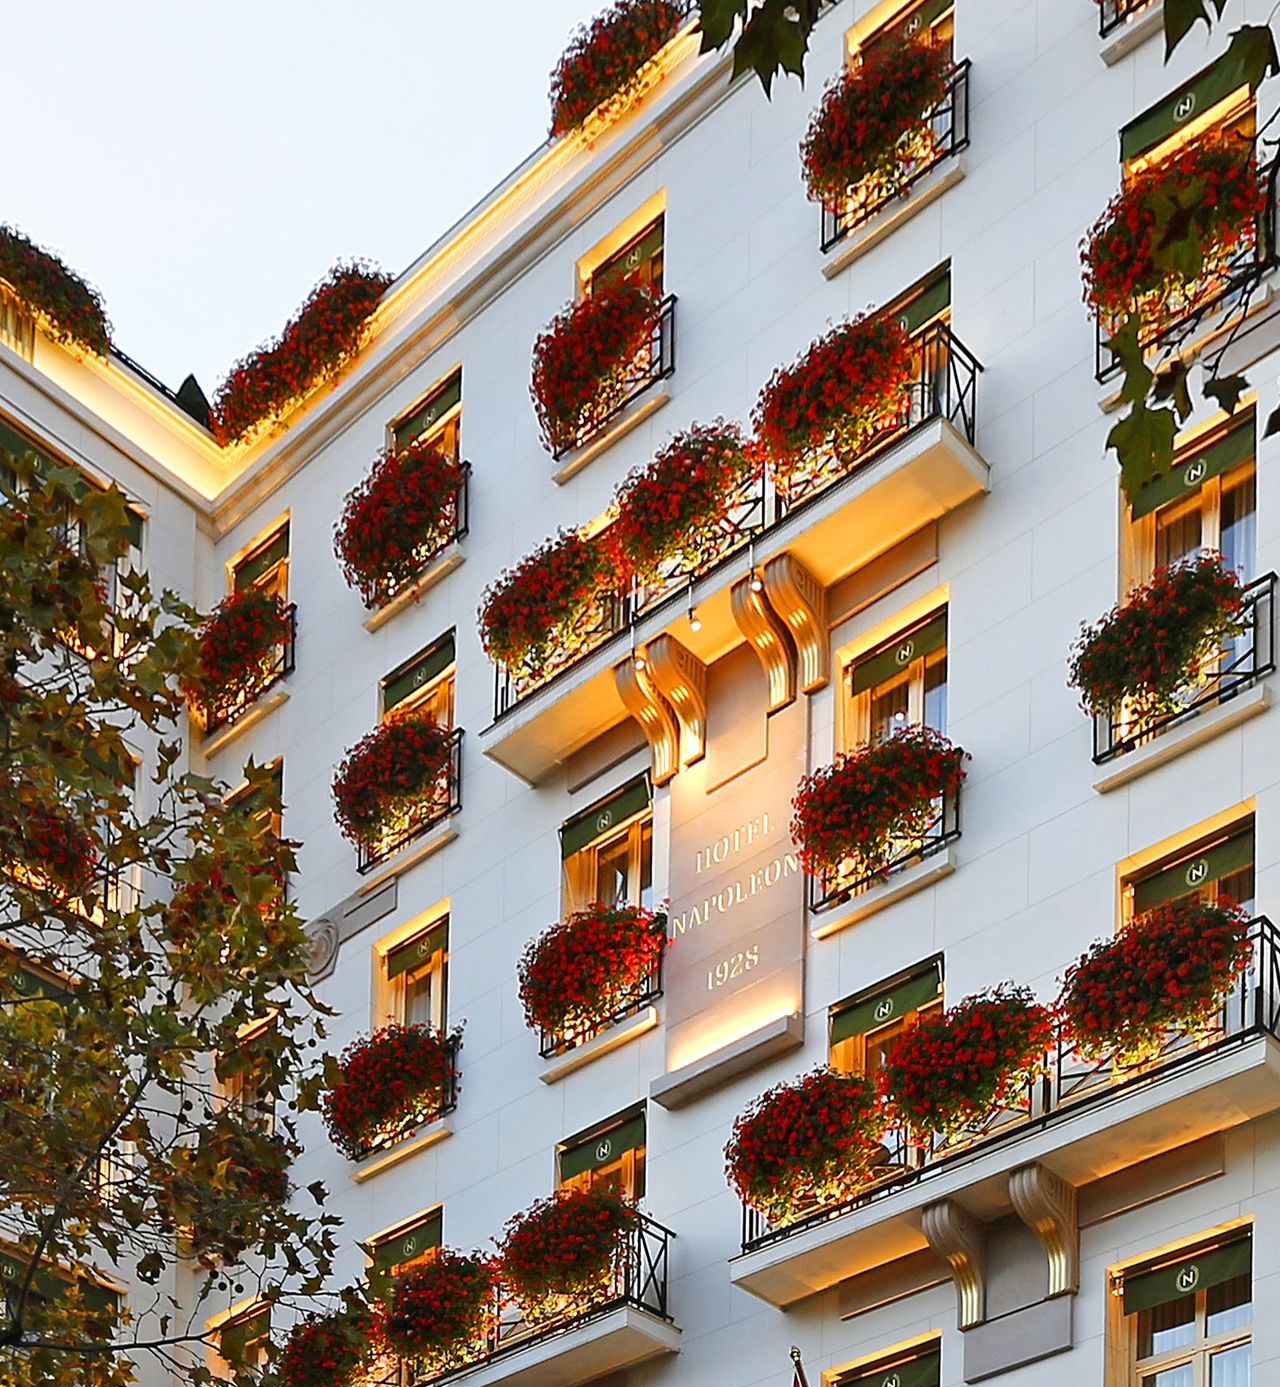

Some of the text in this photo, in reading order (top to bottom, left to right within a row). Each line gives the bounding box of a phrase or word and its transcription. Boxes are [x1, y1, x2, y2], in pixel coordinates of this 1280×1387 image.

[695, 812, 775, 874] HOTEL
[671, 852, 800, 939] NAPOLEON
[705, 944, 760, 991] 1928
